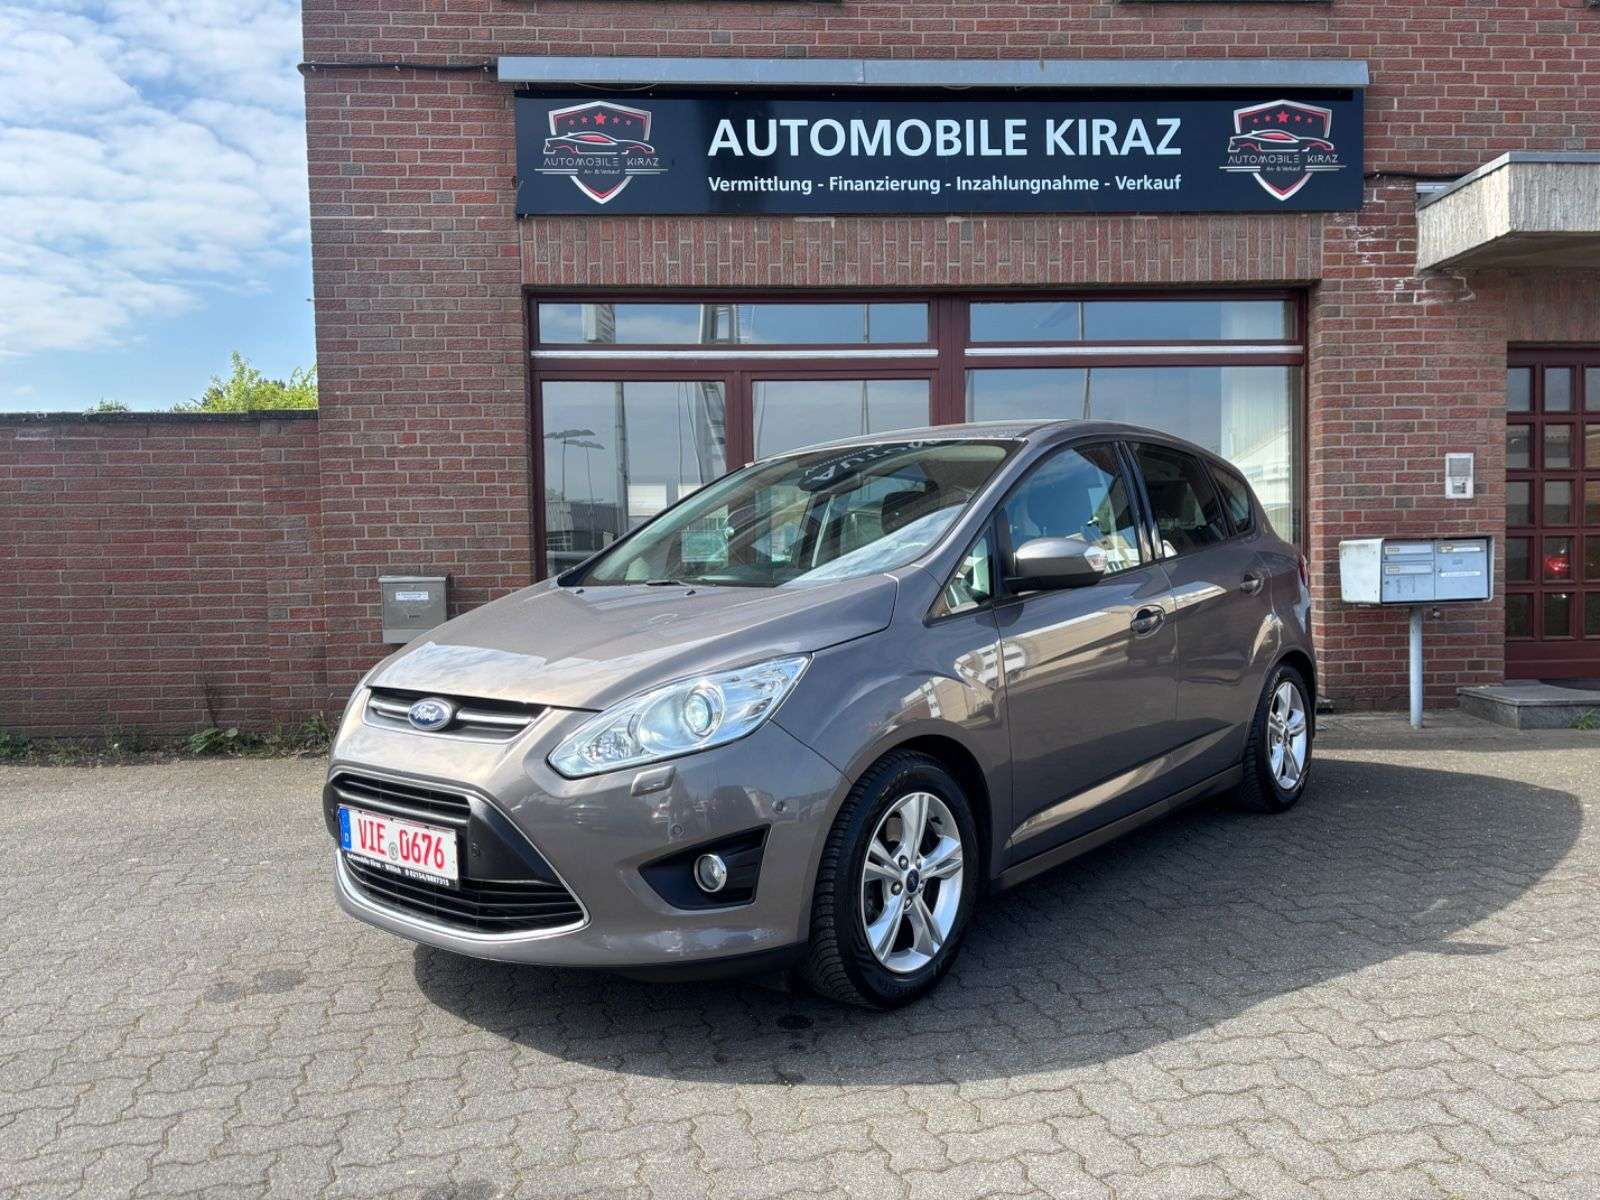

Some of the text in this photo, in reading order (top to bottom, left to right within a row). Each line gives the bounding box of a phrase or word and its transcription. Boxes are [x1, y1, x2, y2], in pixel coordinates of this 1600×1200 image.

[707, 117, 1182, 157] AUTOMOBILE KIRAZ
[543, 157, 660, 167] AUTOMOBILE KIRAZ
[1228, 154, 1339, 164] AUTOMOBILE KIRAZ
[708, 176, 812, 195] Vermittlung
[829, 176, 941, 195] Finanzierung
[956, 175, 1100, 194] Inzahlungnahme
[1115, 174, 1182, 191] Verkauf
[358, 819, 386, 854] VIE
[399, 829, 445, 869] 0676
